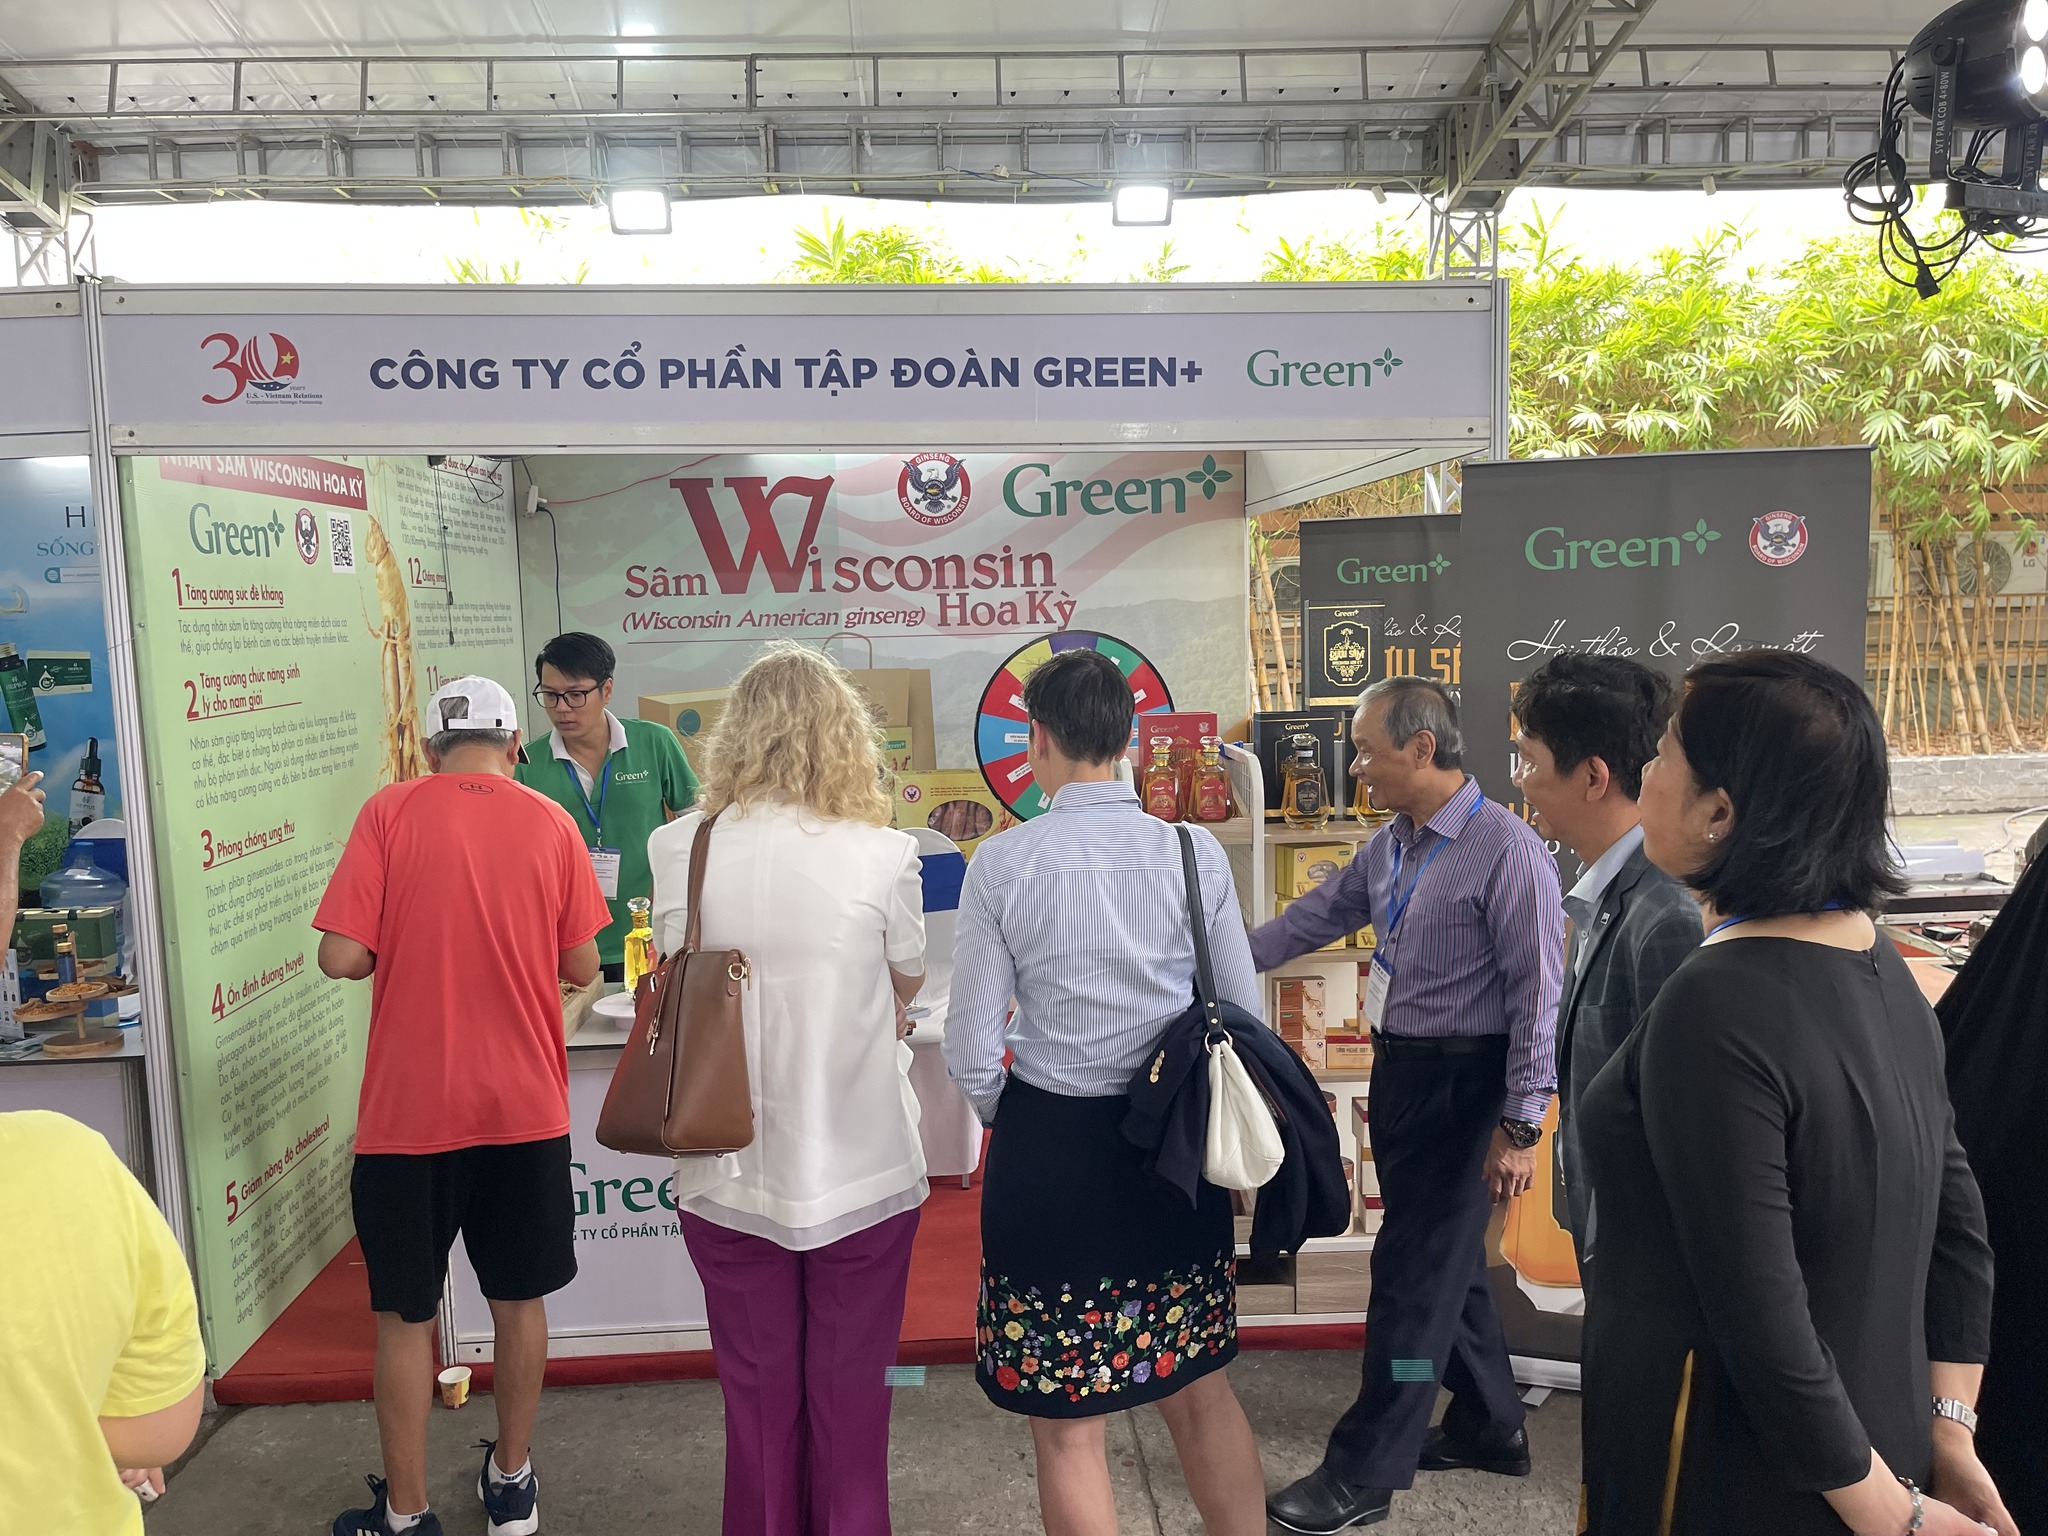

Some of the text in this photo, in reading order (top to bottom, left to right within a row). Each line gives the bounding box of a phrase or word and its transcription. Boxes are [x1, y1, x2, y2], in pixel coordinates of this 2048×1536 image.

[1938, 100, 1947, 118] COB
[1936, 119, 1946, 136] PAR
[1935, 138, 1944, 154] SVT
[369, 341, 1204, 397] CÔNG TY CỔ PHẦN TẬP ĐOÀN GREEN+
[915, 453, 951, 464] GINSENG
[249, 457, 321, 491] WISCONSIN
[323, 472, 348, 496] HOA
[349, 474, 363, 499] KỲ
[900, 495, 969, 525] BOARD OF WISCONSIN
[1765, 513, 1793, 521] GINSENG
[36, 536, 94, 556] SỐNG
[624, 475, 1057, 598] Sâm Wisconsin
[1752, 544, 1766, 561] BOARD
[1776, 543, 1805, 564] WISCONSIN
[408, 557, 422, 585] 12
[185, 584, 208, 606] Tăng
[209, 585, 234, 606] cường
[236, 586, 248, 601] sức
[250, 584, 260, 601] đề
[260, 584, 284, 606] kháng
[622, 607, 926, 633] (Wisconsin American ginseng)
[936, 590, 1078, 632] Hoa Kỳ
[193, 618, 210, 636] dụng
[1410, 613, 1428, 637] &
[1648, 620, 1682, 657] &
[184, 662, 300, 719] 2 Tăng cường chức năng sinh
[202, 689, 264, 718] lý cho nam giới
[201, 818, 296, 868] 3 Phòng chống ung thư
[212, 951, 304, 1020] 4 Ổn định đường huyết
[226, 1180, 239, 1223] 5
[241, 1177, 262, 1201] Giảm
[295, 1114, 330, 1155] cholesterol
[580, 1222, 683, 1240] TY CỔ PHẦN TẬ
